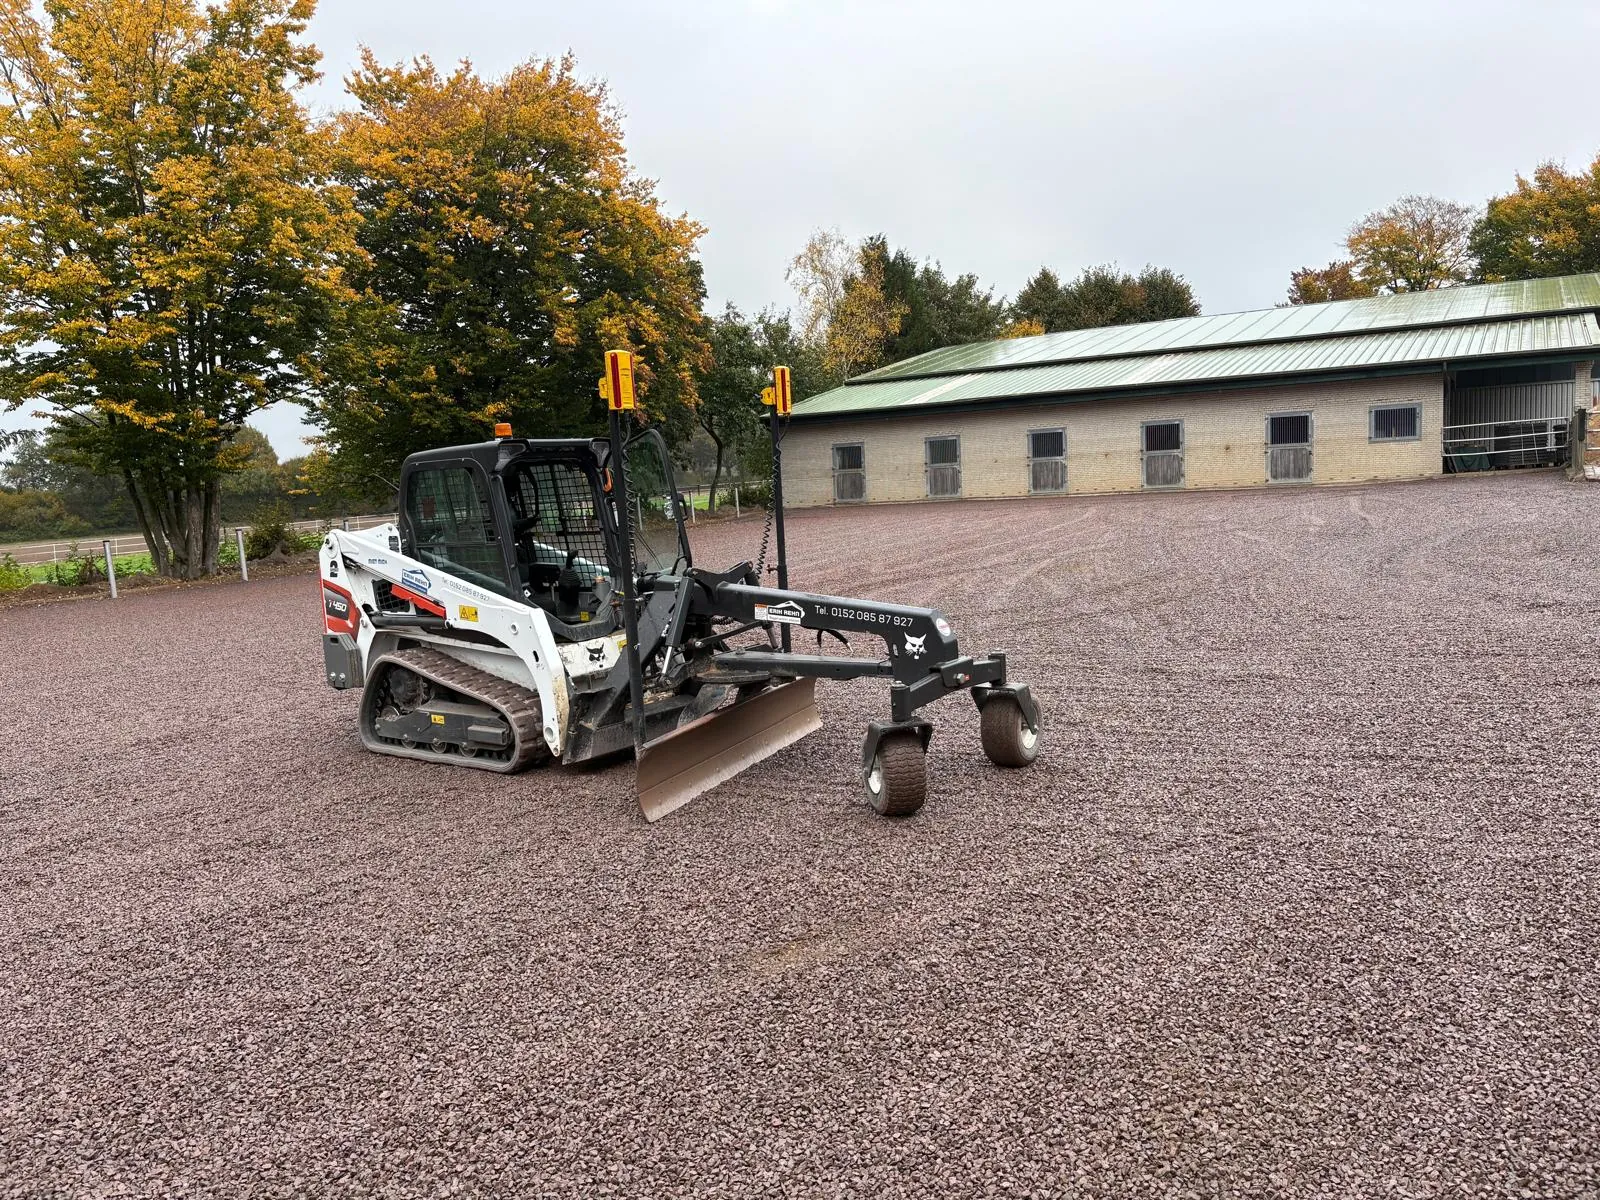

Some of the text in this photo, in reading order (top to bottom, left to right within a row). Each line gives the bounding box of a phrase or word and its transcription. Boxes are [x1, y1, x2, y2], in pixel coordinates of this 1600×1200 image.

[449, 580, 462, 590] 0152
[328, 599, 347, 612] T450
[769, 607, 783, 615] ERIK
[783, 609, 800, 617] REHN
[814, 605, 914, 627] Tel. 0152 085 87 927
